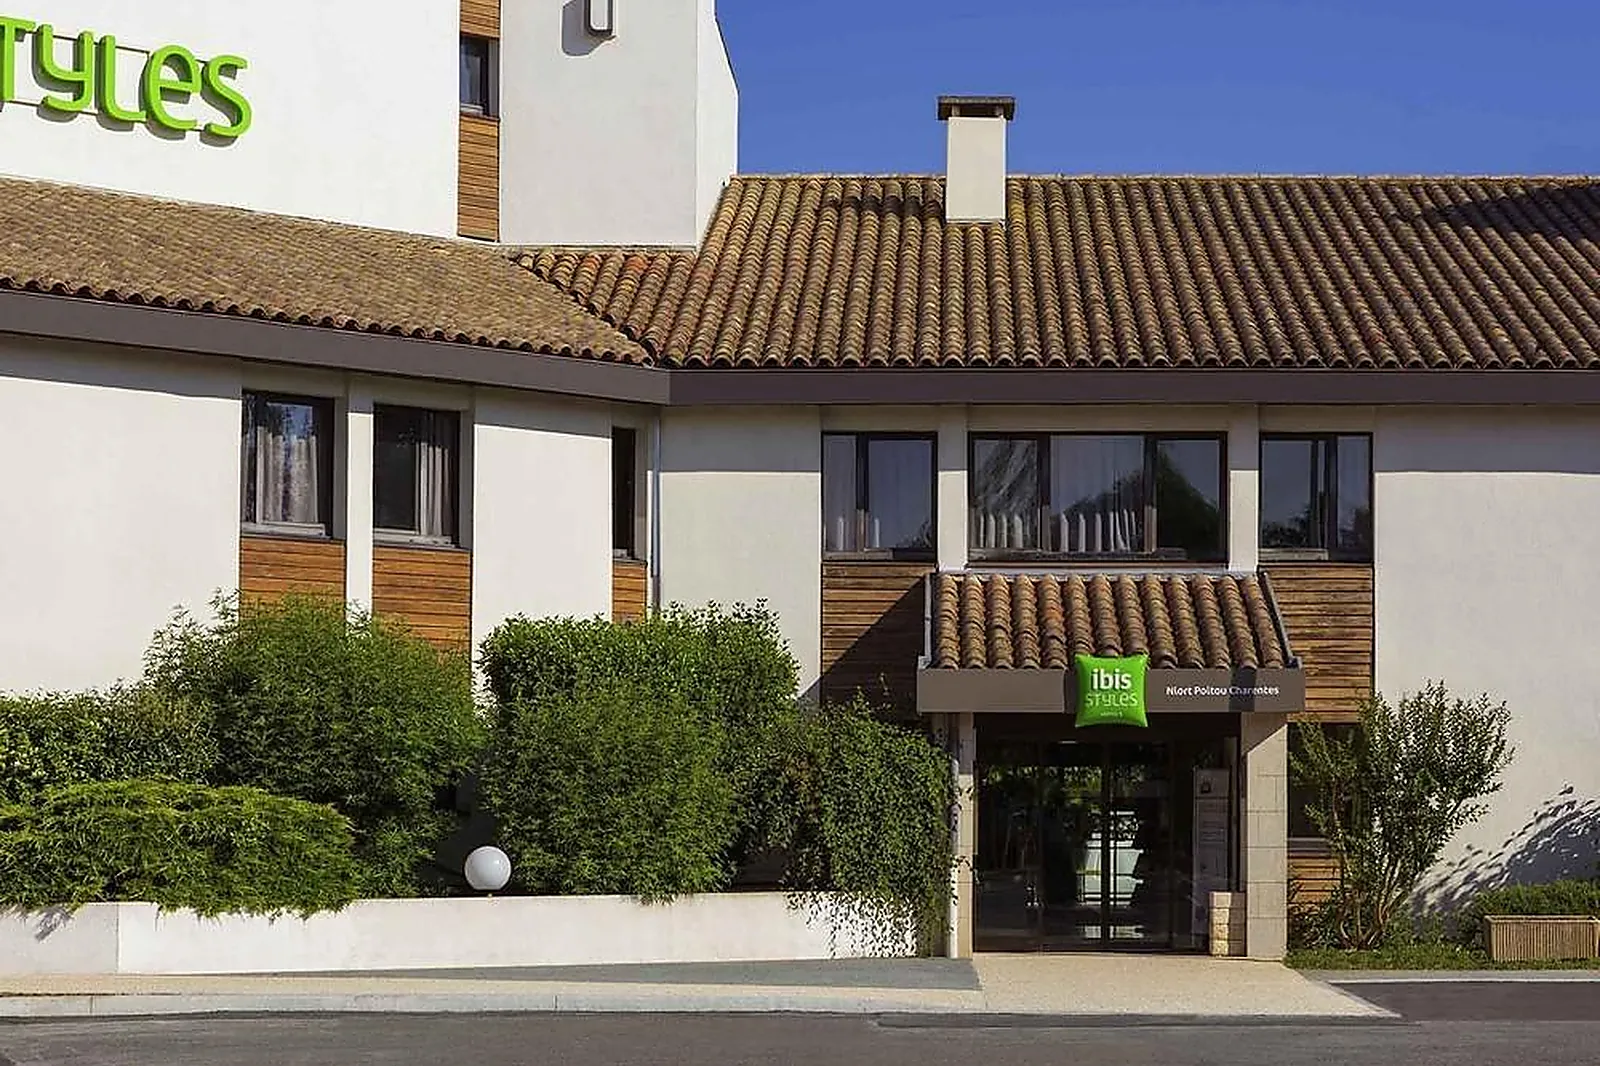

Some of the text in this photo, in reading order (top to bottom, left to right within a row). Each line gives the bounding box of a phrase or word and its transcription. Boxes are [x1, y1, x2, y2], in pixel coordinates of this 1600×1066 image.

[1092, 668, 1132, 690] ibis
[1194, 686, 1227, 696] Poitou
[1229, 686, 1280, 696] Charentes
